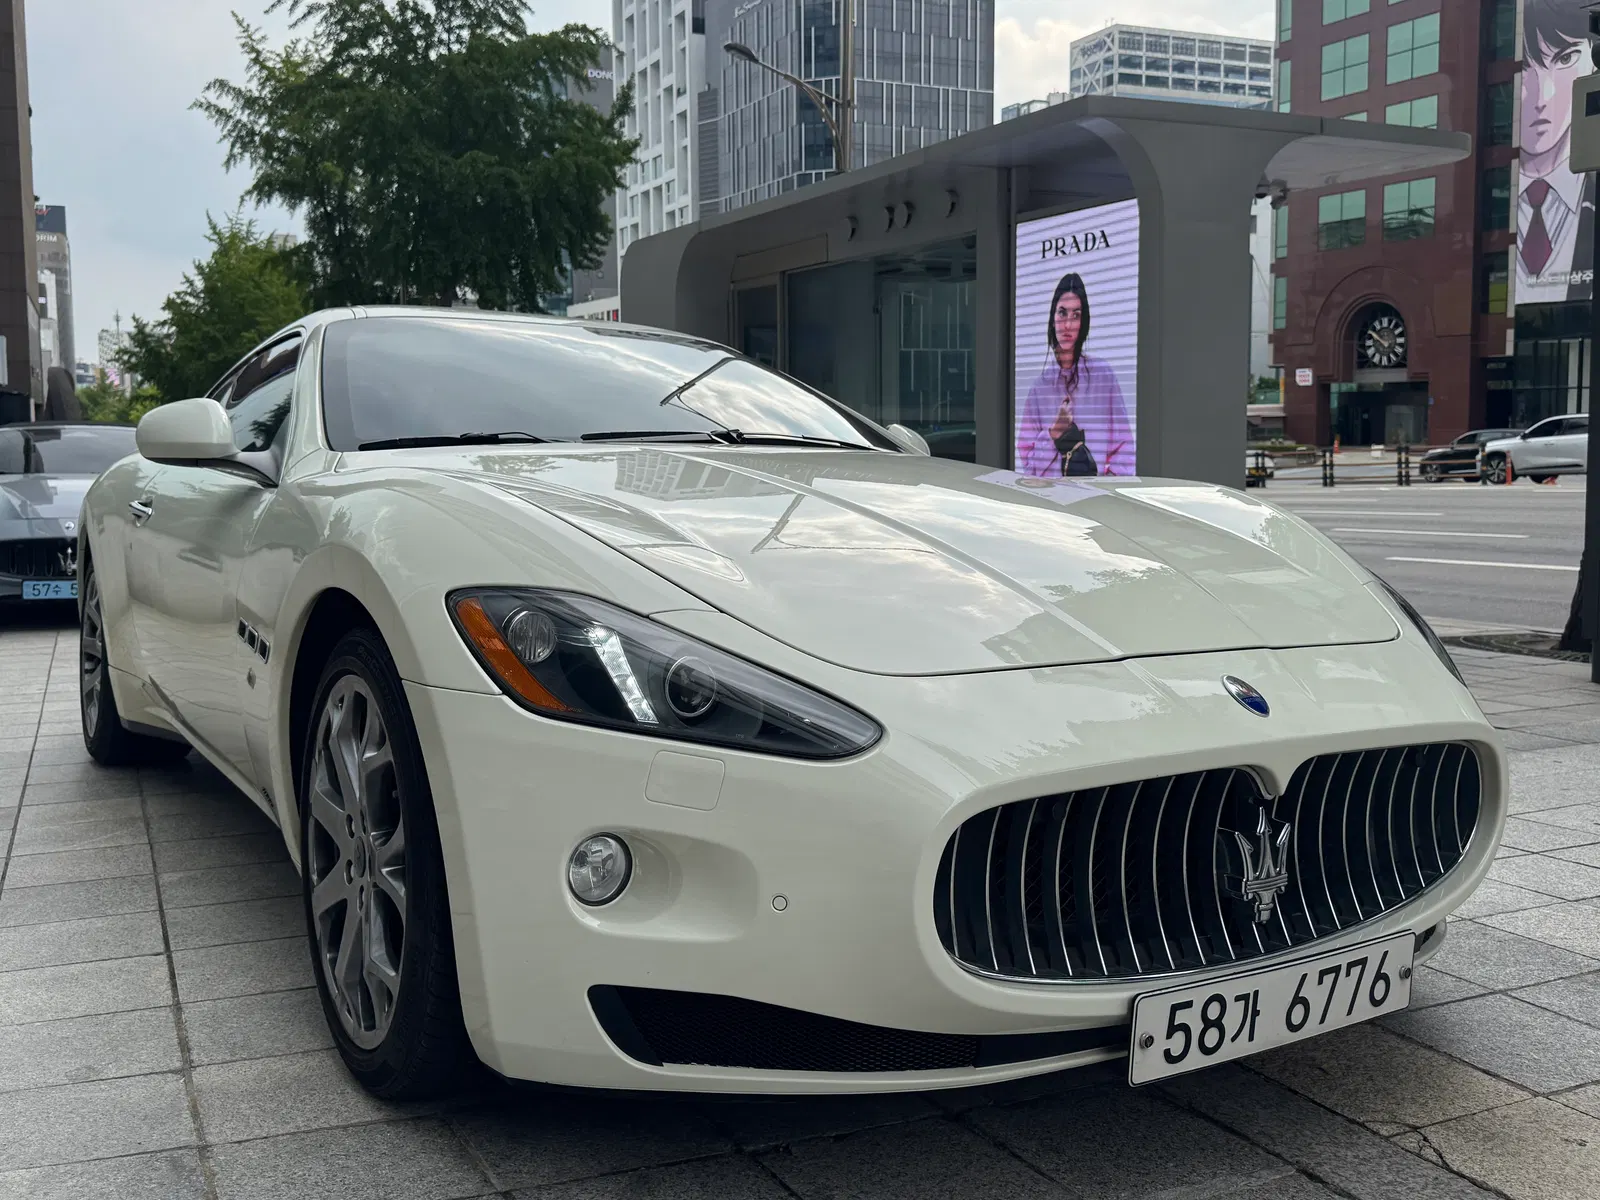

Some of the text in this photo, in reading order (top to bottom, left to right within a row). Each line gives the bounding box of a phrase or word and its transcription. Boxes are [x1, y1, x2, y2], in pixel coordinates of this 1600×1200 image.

[1041, 229, 1111, 259] PRADA
[32, 583, 62, 597] 57수
[1163, 950, 1391, 1065] 58가 6776
